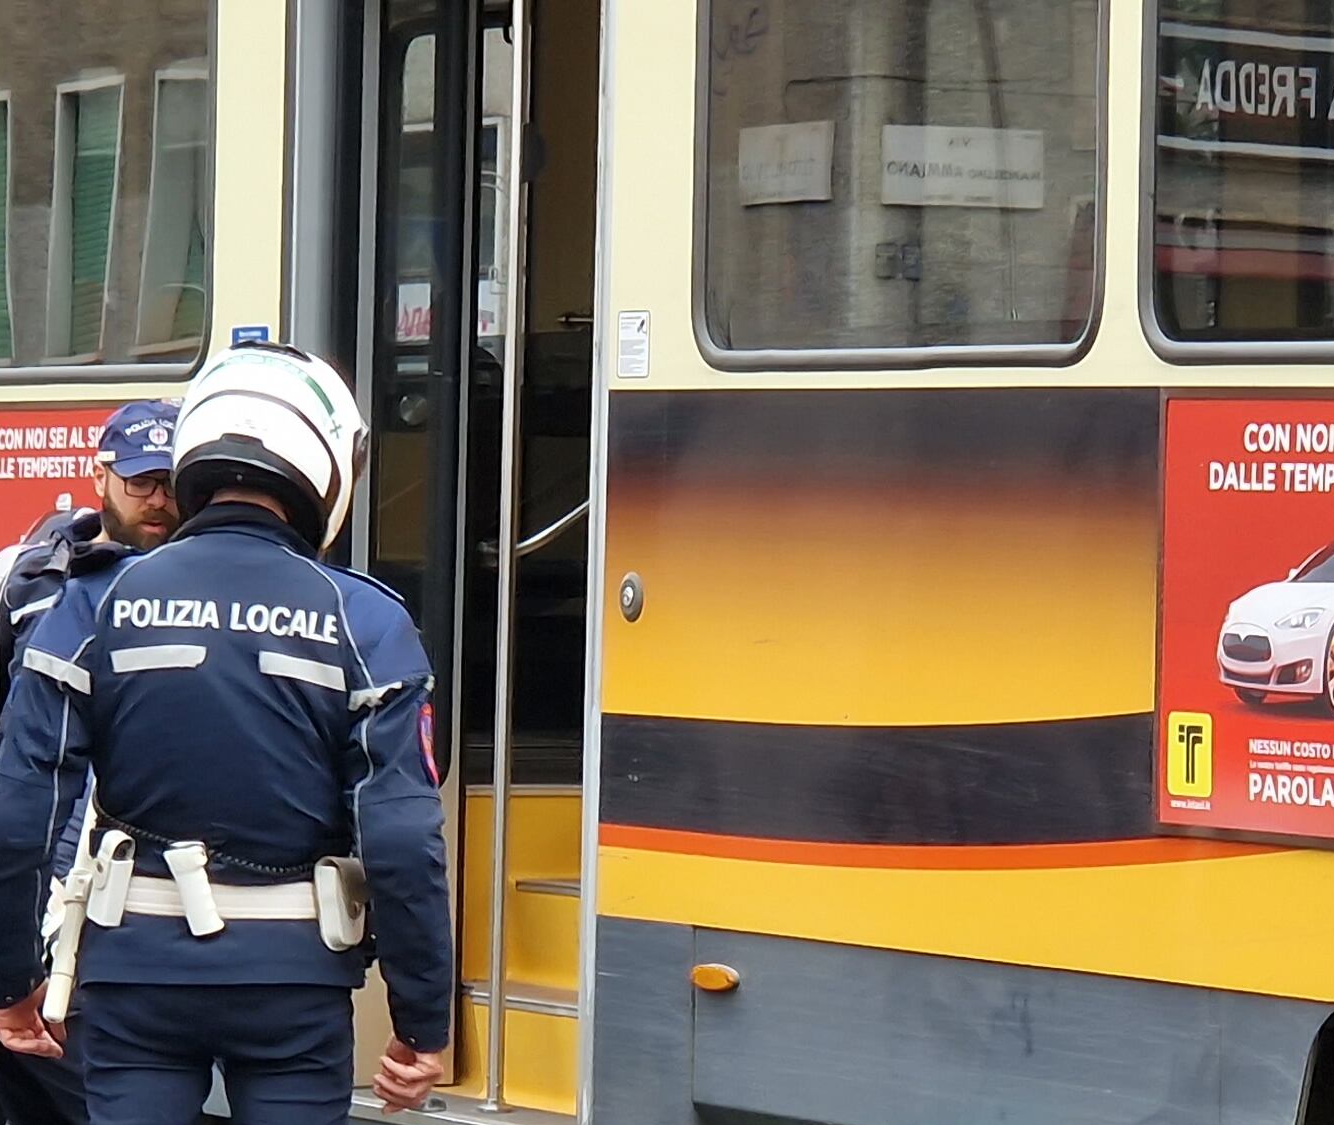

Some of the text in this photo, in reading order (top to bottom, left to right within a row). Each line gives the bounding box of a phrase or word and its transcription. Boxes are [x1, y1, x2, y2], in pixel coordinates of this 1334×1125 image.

[25, 427, 47, 450] NOI
[49, 426, 67, 450] SEI
[69, 426, 86, 449] AL
[1244, 423, 1291, 452] CON
[1295, 423, 1334, 453] NOI
[17, 456, 75, 478] TEMPESTE
[78, 456, 98, 478] TA
[1209, 461, 1276, 491] DALLE
[113, 598, 339, 645] POLIZIA LOCALE
[1248, 738, 1291, 756] NESSUN
[1293, 741, 1331, 759] COSTO
